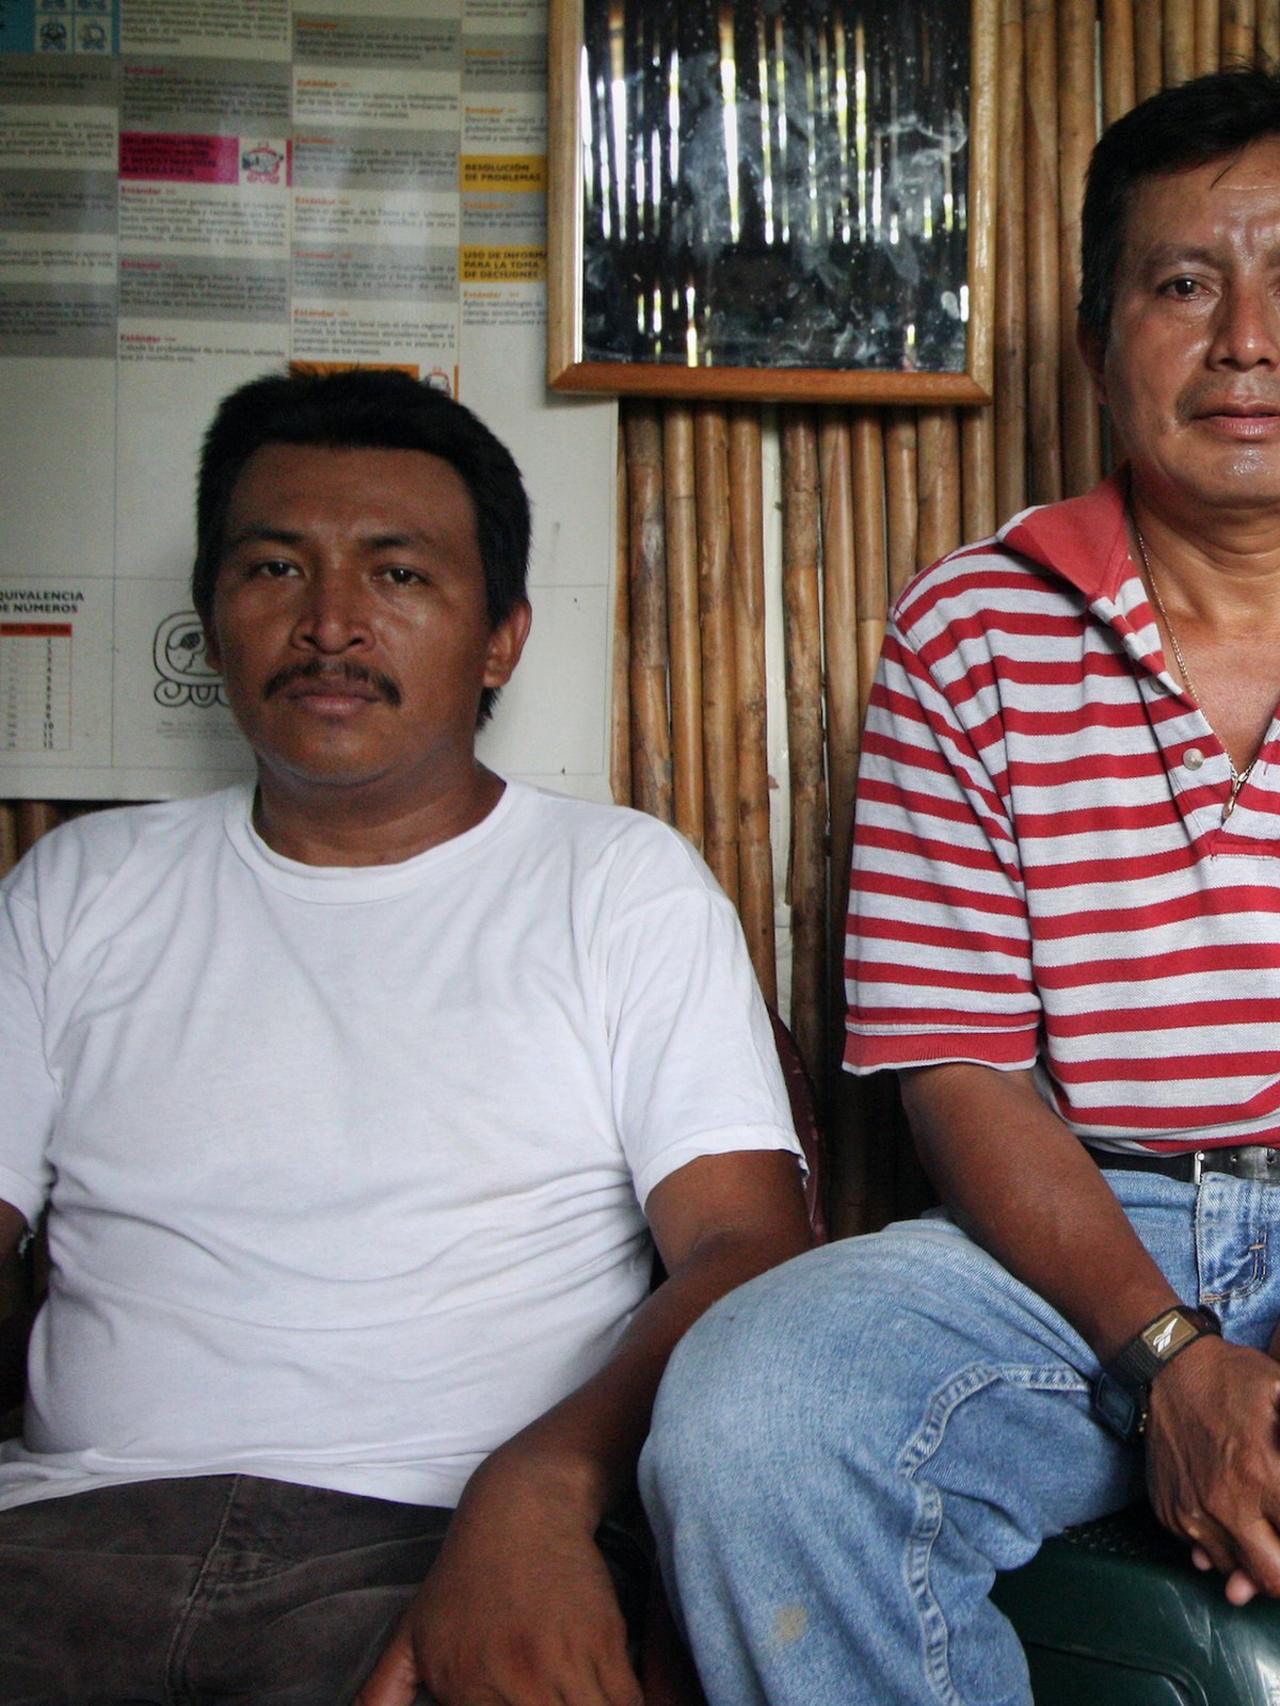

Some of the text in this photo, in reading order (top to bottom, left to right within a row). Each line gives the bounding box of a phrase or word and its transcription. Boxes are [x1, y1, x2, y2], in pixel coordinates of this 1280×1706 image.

[481, 174, 541, 182] PROBLEMAS
[464, 251, 485, 259] USO
[464, 261, 539, 269] PARA LA TOMA
[480, 271, 538, 279] DECISIONES
